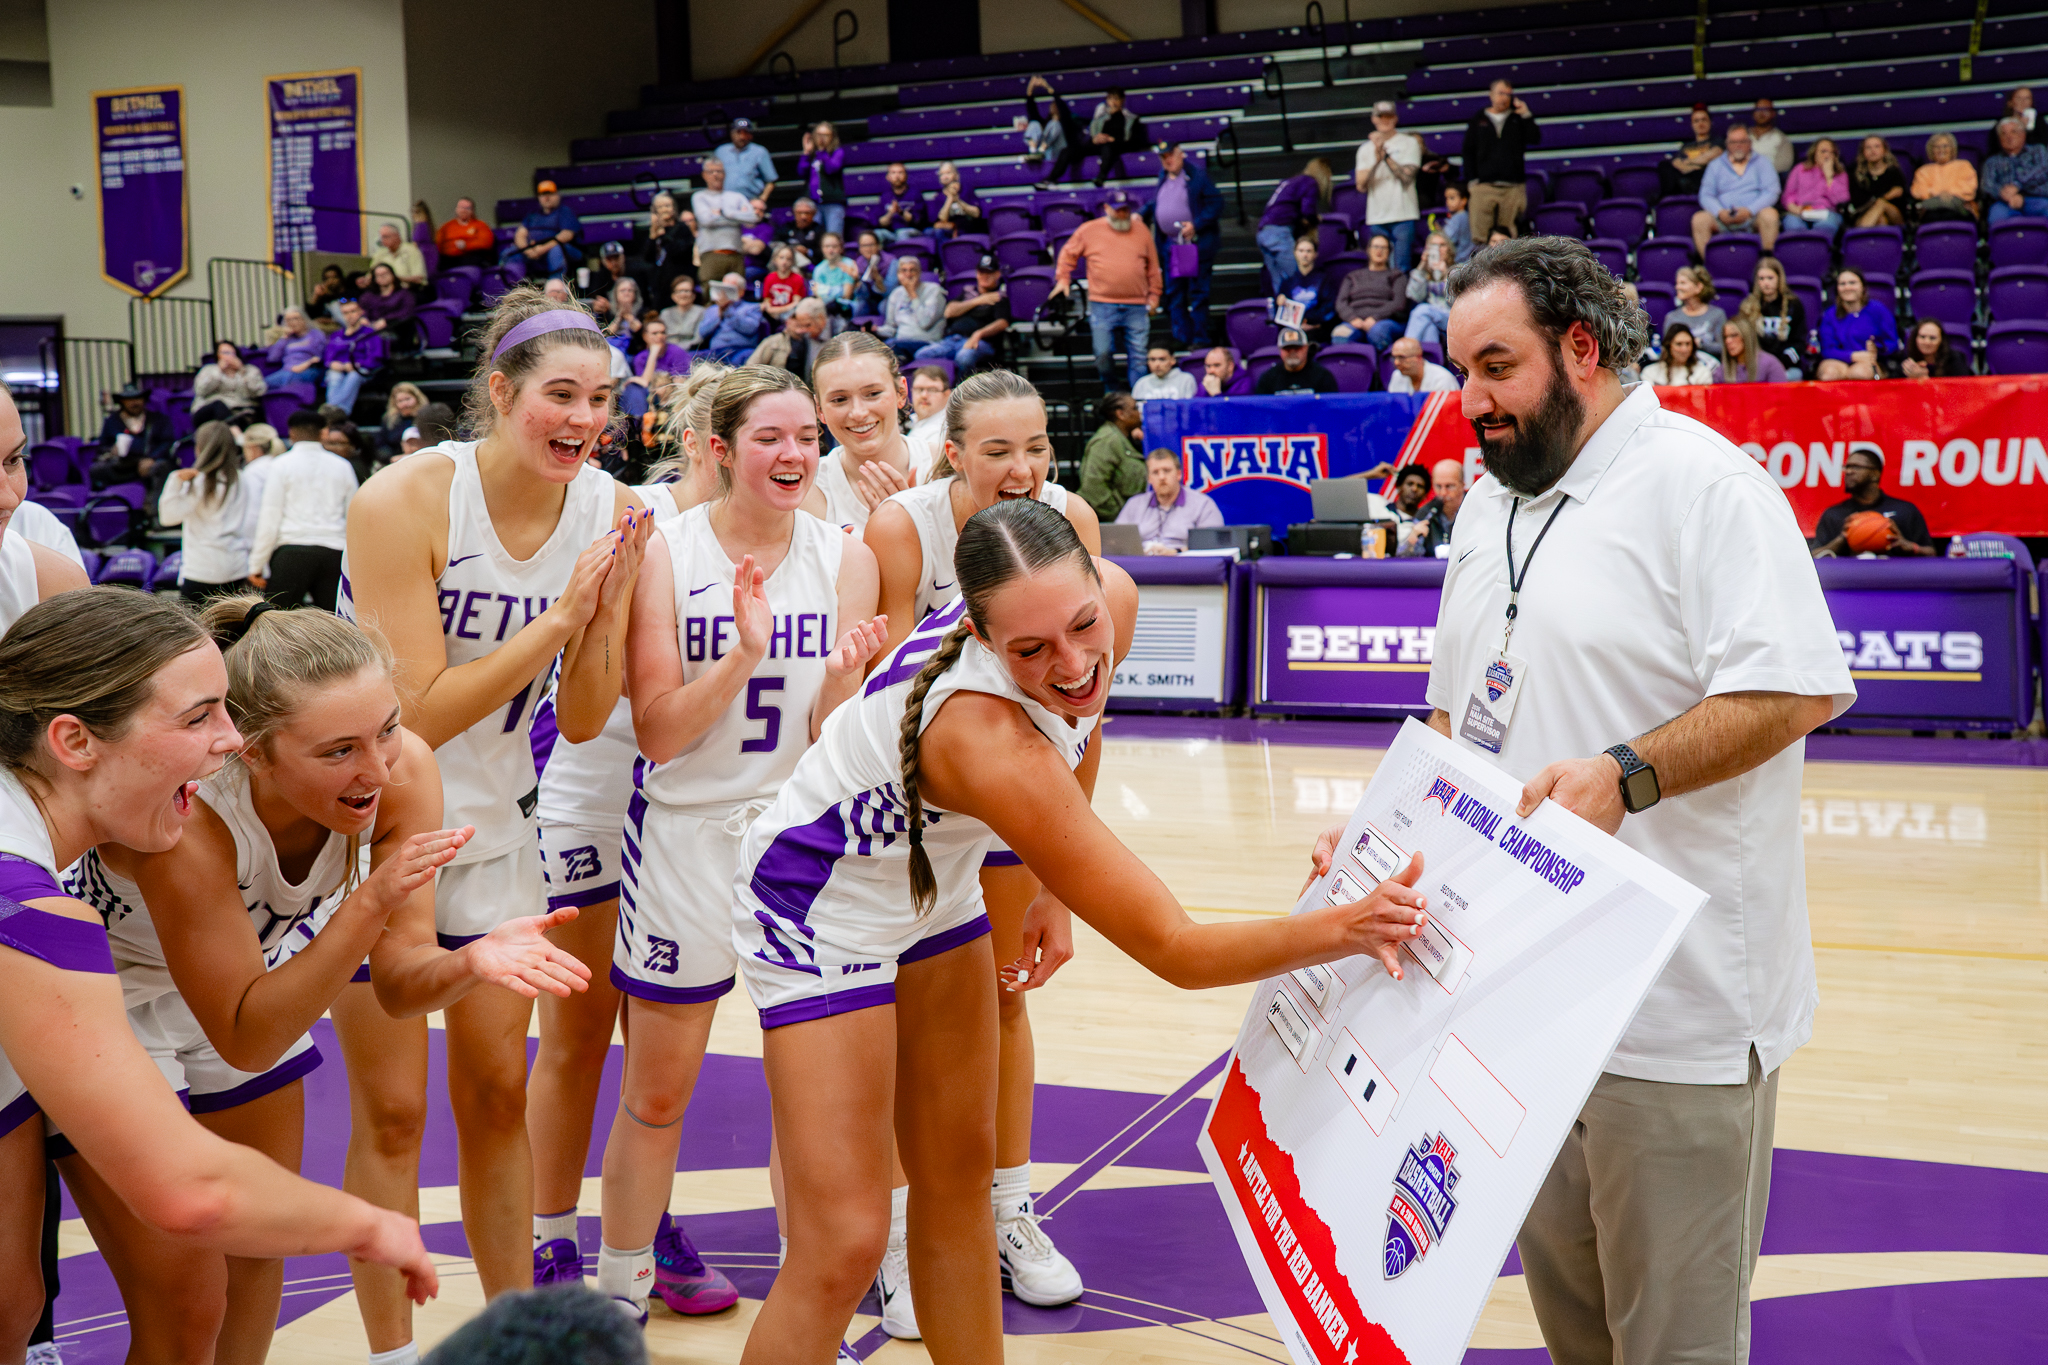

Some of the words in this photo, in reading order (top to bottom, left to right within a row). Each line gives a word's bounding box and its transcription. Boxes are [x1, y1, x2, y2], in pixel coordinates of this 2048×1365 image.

[1186, 437, 1321, 491] NAIA
[438, 587, 562, 641] BETH
[686, 613, 832, 662] BEHEL
[1147, 674, 1195, 686] SMITH
[739, 675, 787, 755] 5
[1466, 717, 1500, 739] SUPERVISOR
[1482, 715, 1495, 727] SITE
[1426, 778, 1457, 812] NAIA
[1451, 792, 1502, 842] NATIONAL
[1499, 825, 1585, 894] CHAMPIONSHIP
[1440, 883, 1456, 900] SECOND
[1453, 894, 1469, 911] ROUND
[1430, 1135, 1456, 1173] NAIA
[1399, 1152, 1452, 1233] BASKETBALL
[1242, 1152, 1271, 1208] BATTLE
[1261, 1193, 1283, 1232] FOR
[1274, 1216, 1298, 1259] THE
[1287, 1243, 1312, 1286] RED
[1302, 1271, 1349, 1351] BANNER
